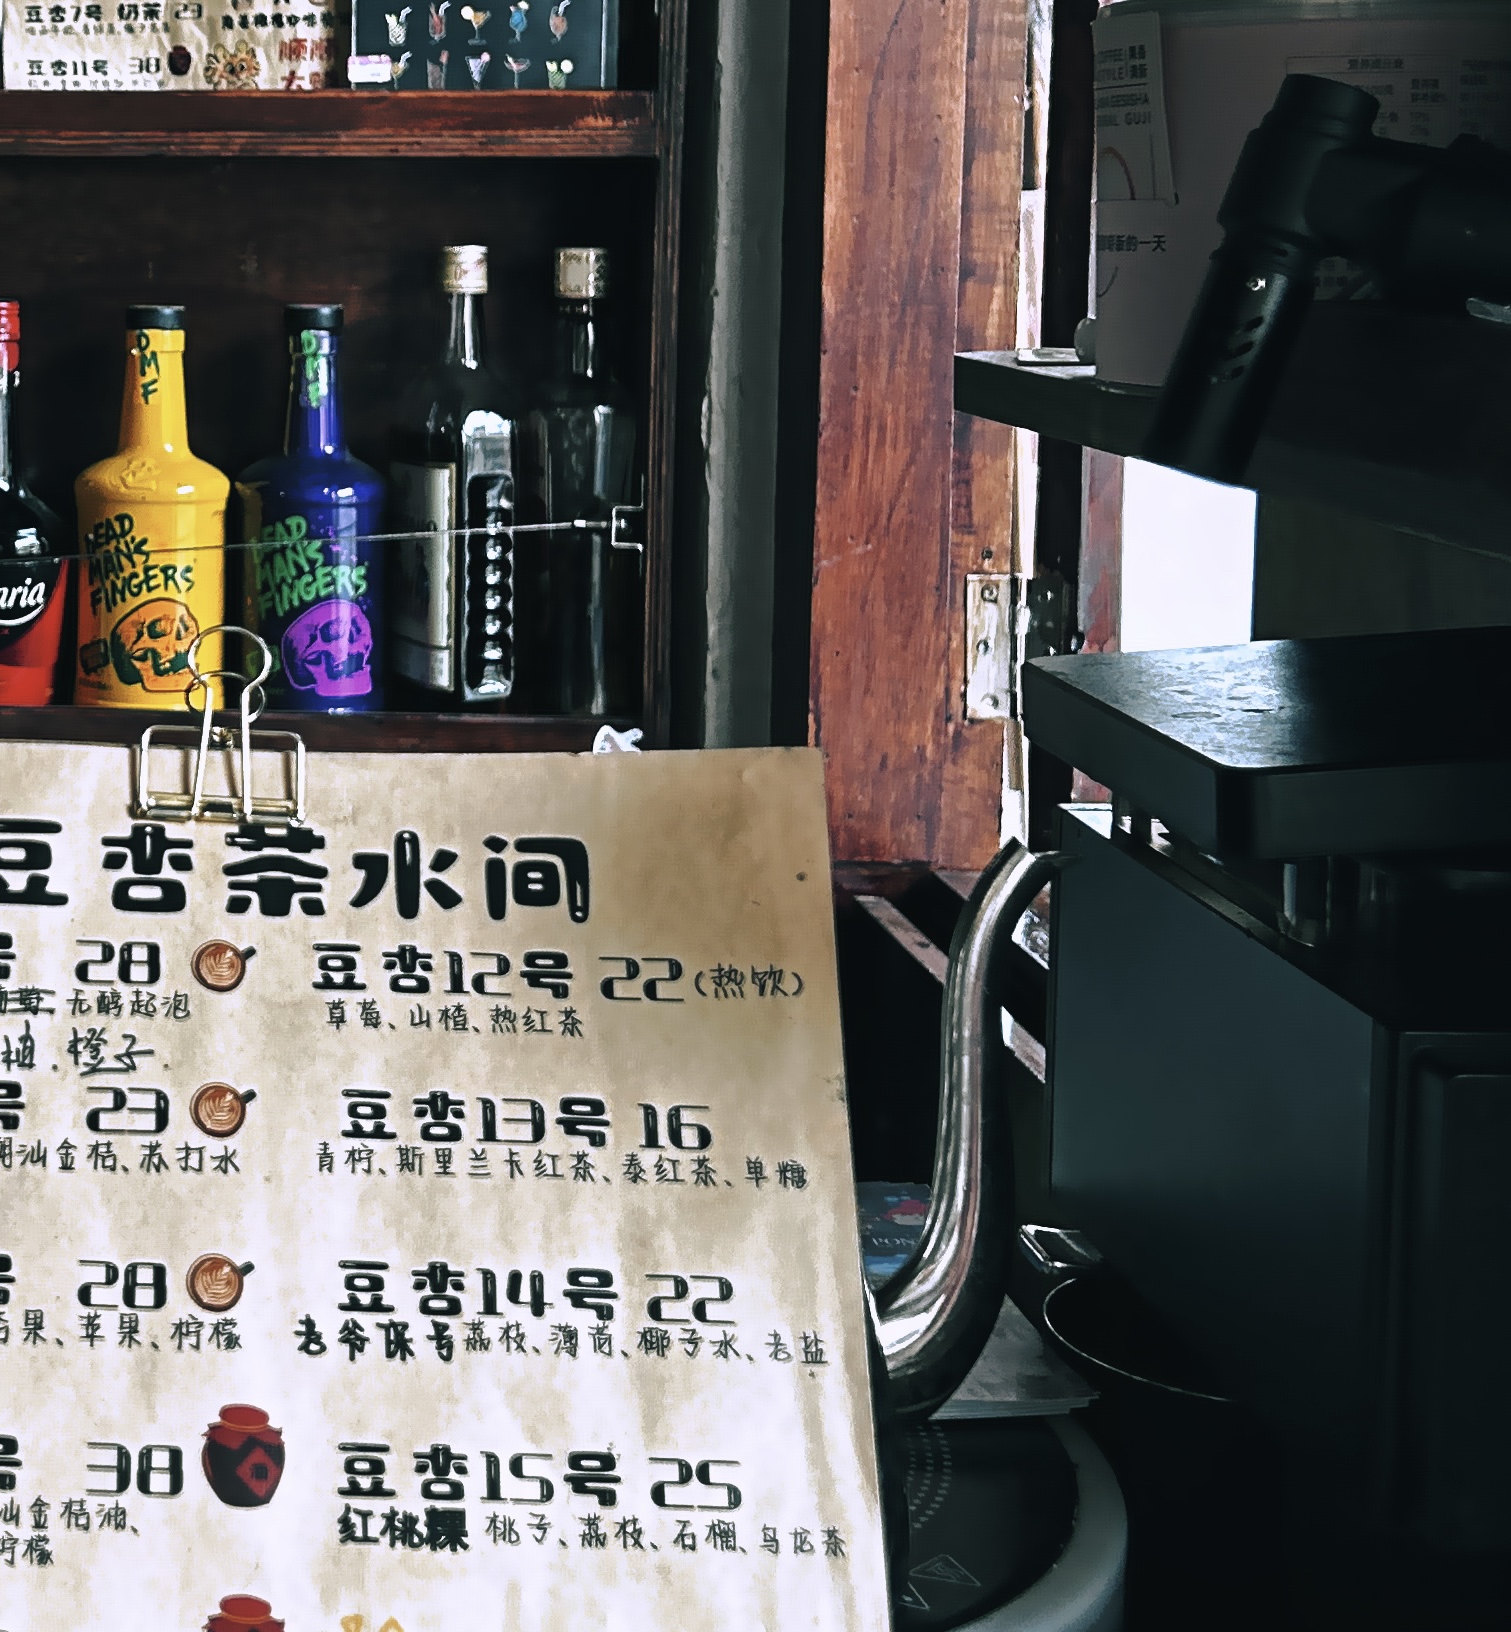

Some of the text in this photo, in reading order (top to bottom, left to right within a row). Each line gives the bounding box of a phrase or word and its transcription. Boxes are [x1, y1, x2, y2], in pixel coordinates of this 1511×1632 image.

[90, 564, 195, 616] FINGERS
[260, 564, 369, 620] FINGERS
[74, 938, 162, 985] 28
[312, 943, 574, 1000] 豆杏12号
[599, 955, 685, 1002] 22
[85, 1086, 170, 1135] 23
[340, 1088, 713, 1151] 豆杏13号 16
[77, 1259, 169, 1310] 28
[337, 1259, 736, 1323] 豆杏14号 22
[86, 1441, 184, 1496] 38
[336, 1442, 742, 1510] 豆杏15号 25
